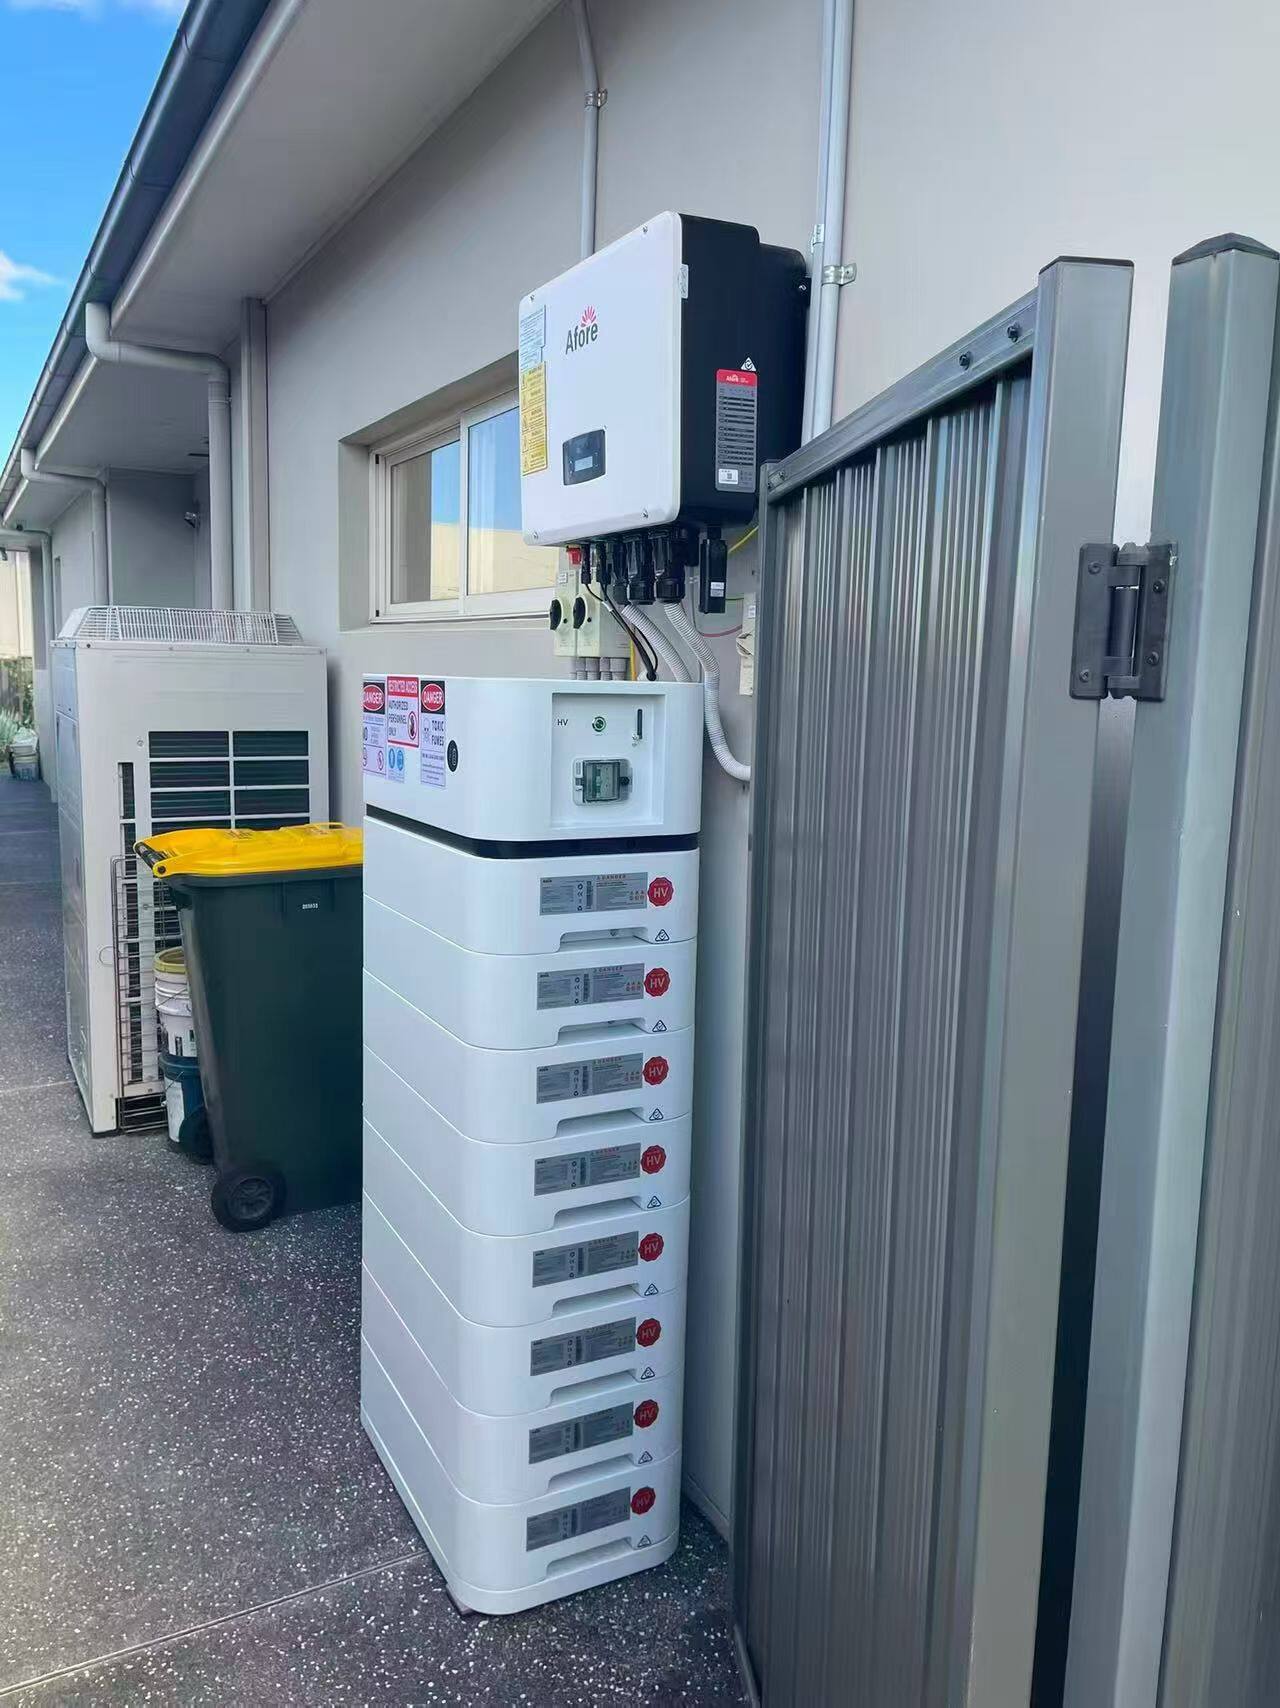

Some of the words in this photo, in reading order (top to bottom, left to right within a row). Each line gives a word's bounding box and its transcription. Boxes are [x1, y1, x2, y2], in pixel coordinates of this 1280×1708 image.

[565, 323, 598, 355] Afore
[423, 691, 444, 705] DANGER
[431, 720, 444, 731] TOXIC
[431, 735, 444, 746] FUMES
[653, 887, 669, 898] HV
[650, 977, 666, 988] HV
[649, 1066, 664, 1077] HV
[646, 1154, 662, 1166] HV
[644, 1242, 659, 1254] HV
[641, 1328, 656, 1339] HV
[639, 1408, 655, 1421] HV
